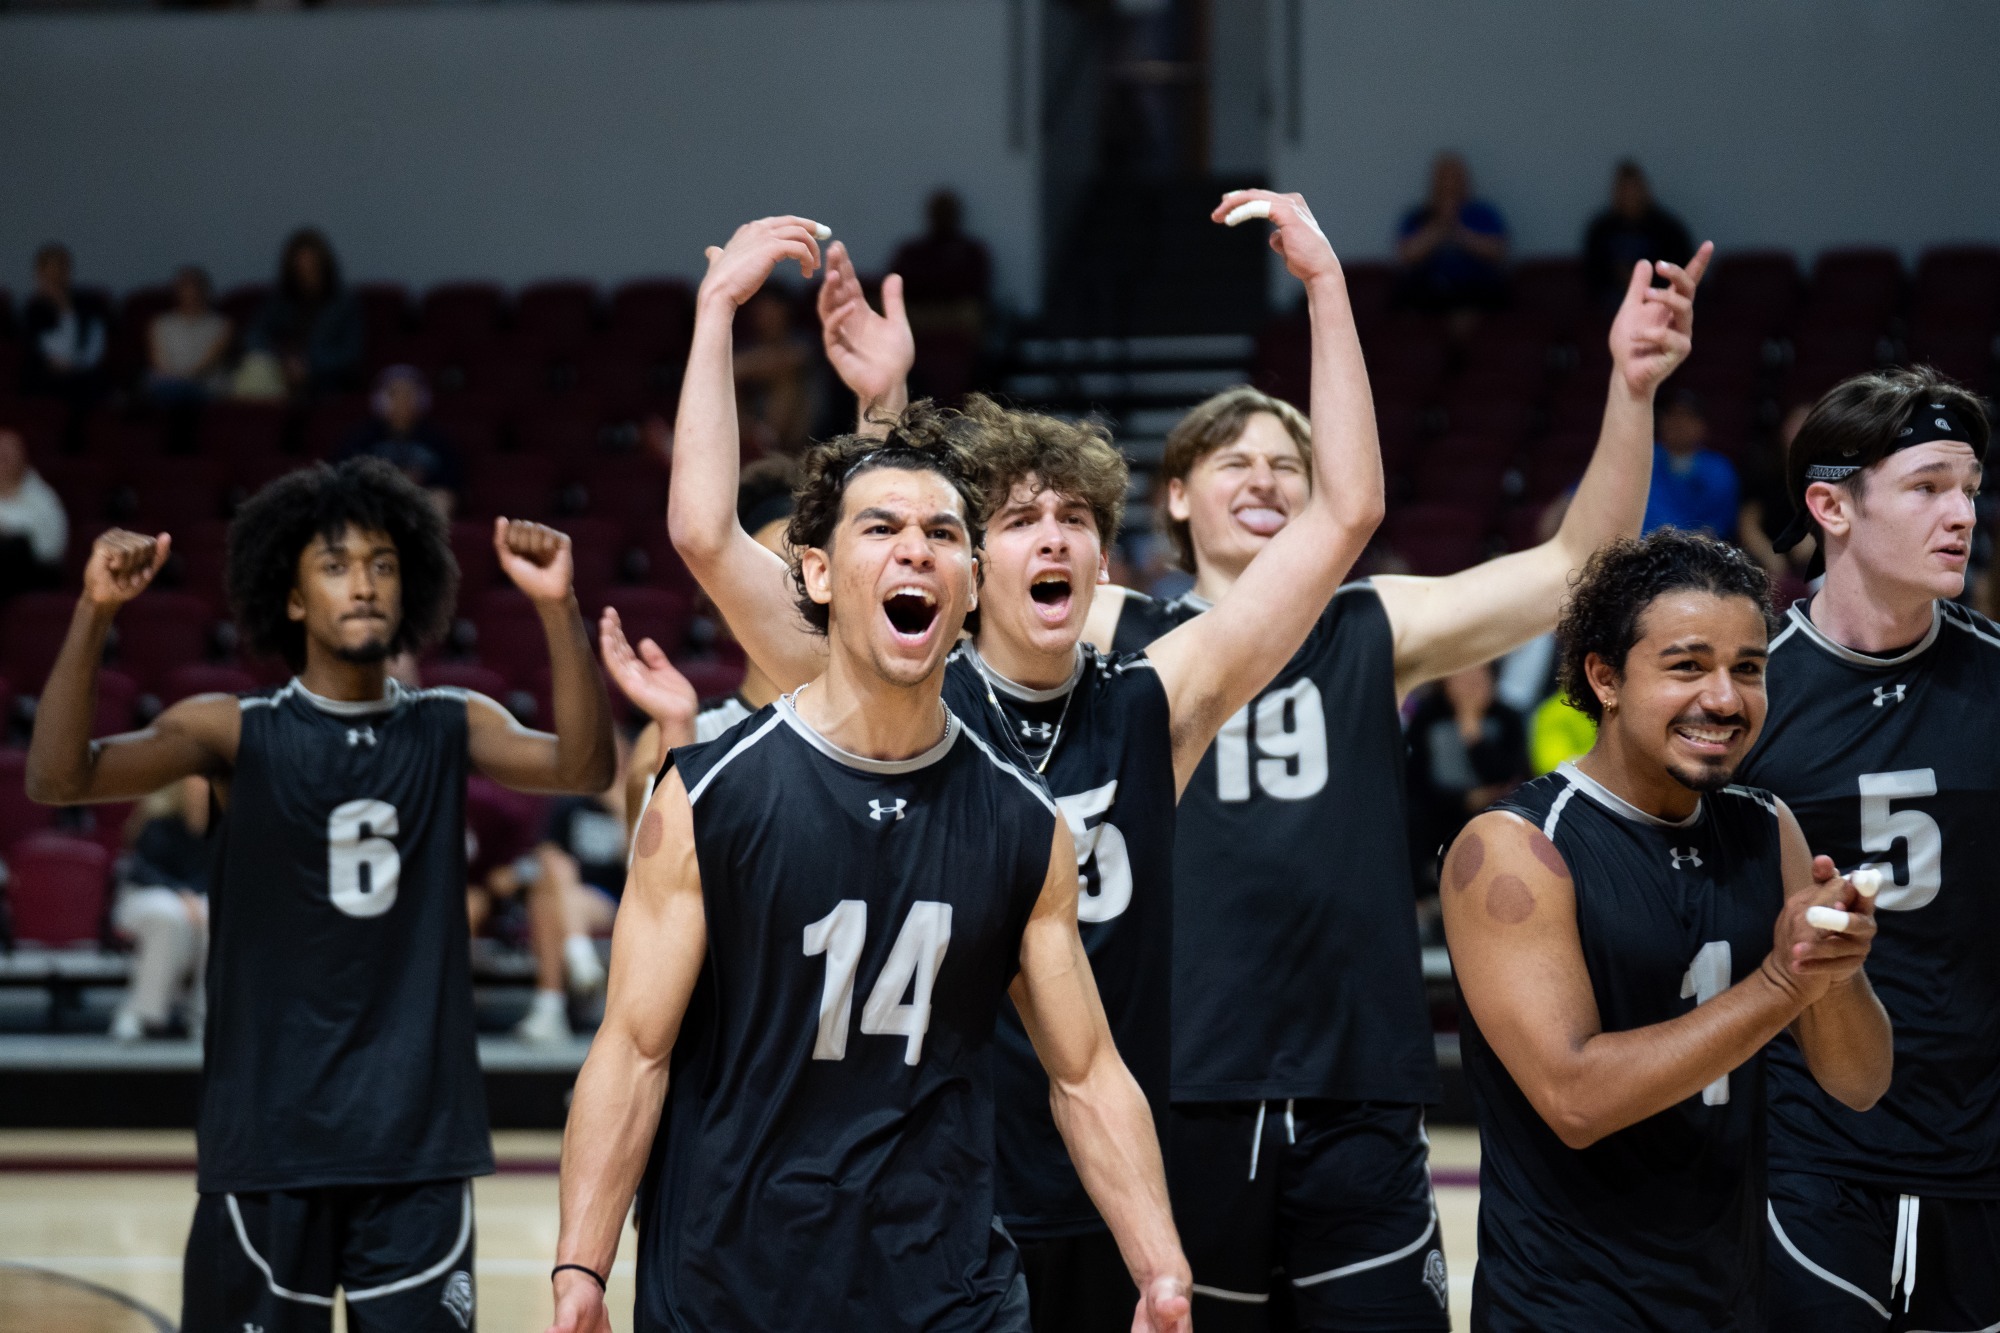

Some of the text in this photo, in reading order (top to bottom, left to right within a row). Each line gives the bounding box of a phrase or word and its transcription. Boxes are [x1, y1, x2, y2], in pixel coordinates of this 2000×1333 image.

[1216, 676, 1329, 801] 19
[328, 800, 399, 918] 6
[1858, 768, 1942, 911] 5
[803, 900, 952, 1065] 14
[1680, 940, 1732, 1106] 1
